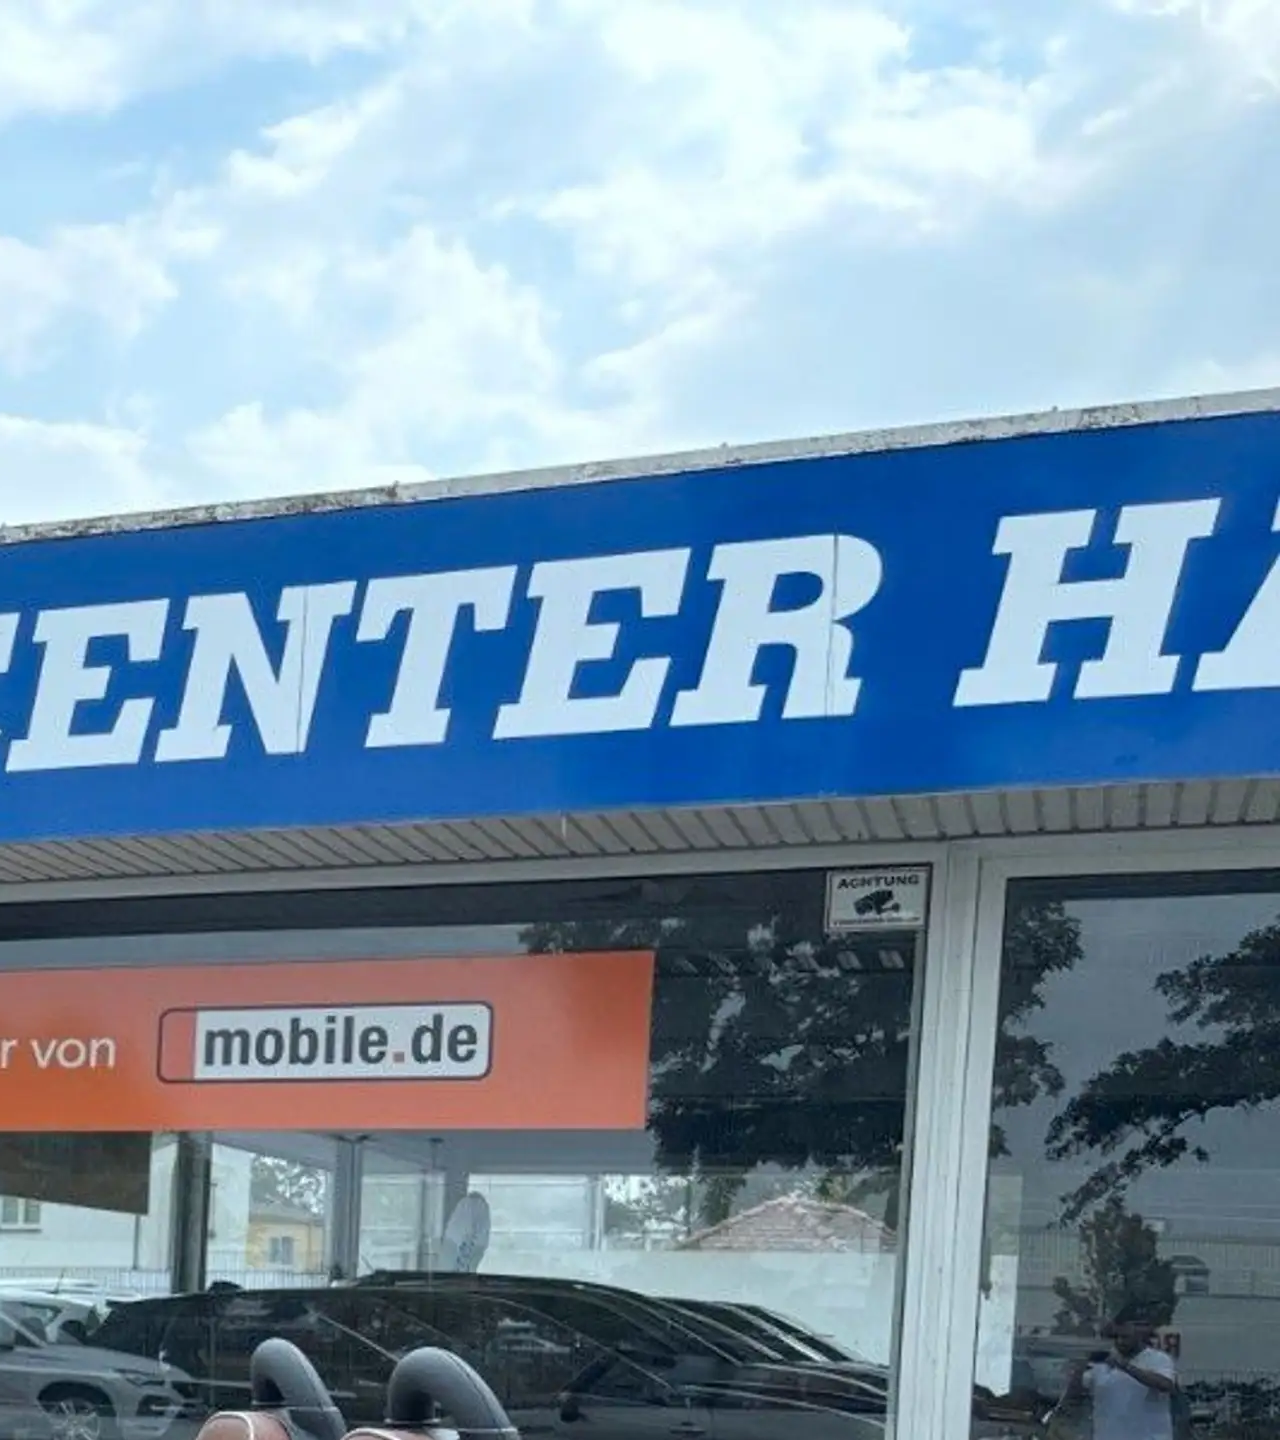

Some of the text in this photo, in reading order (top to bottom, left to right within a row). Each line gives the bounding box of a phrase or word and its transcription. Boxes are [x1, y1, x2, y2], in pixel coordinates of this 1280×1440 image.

[836, 874, 921, 889] ACHTUNG
[30, 1036, 117, 1070] von
[203, 1012, 479, 1067] mobile.de
